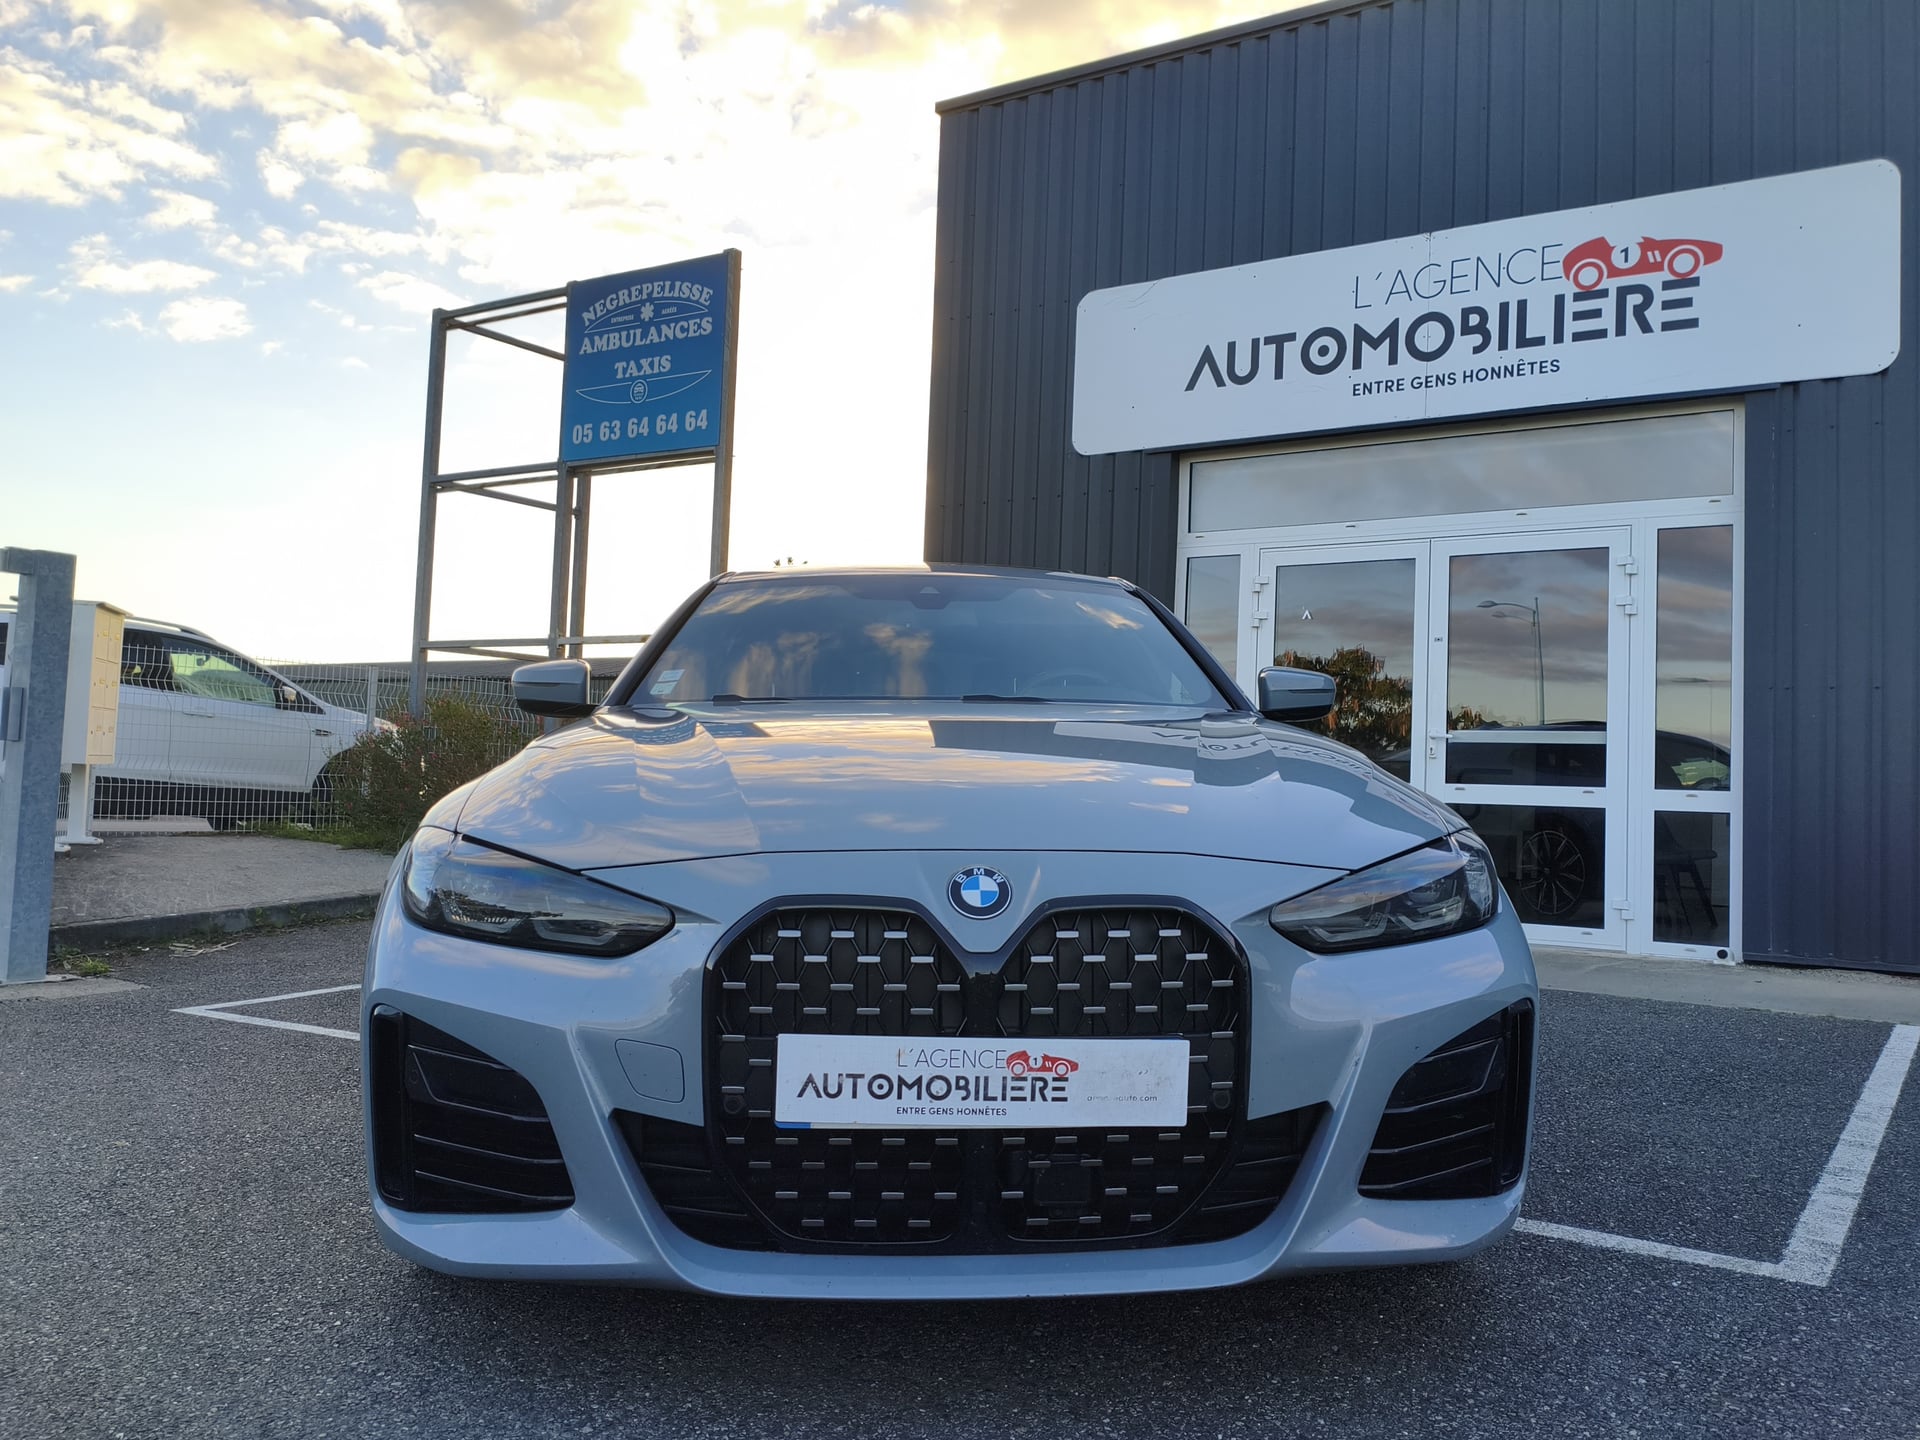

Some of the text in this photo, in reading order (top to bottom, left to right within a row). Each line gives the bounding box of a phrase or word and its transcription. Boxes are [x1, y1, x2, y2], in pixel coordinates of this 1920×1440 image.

[1619, 246, 1632, 264] 1
[582, 281, 713, 326] NEGREPELISSE
[579, 316, 713, 355] AMBULANCES
[614, 355, 671, 379] TAXIS
[1352, 358, 1562, 397] ENTRE GENS HONNÊTES
[572, 409, 708, 445] 05 63 64 64 64
[955, 868, 1004, 883] BMW
[896, 1105, 1007, 1116] ENTRE GENS HONNÊTES
